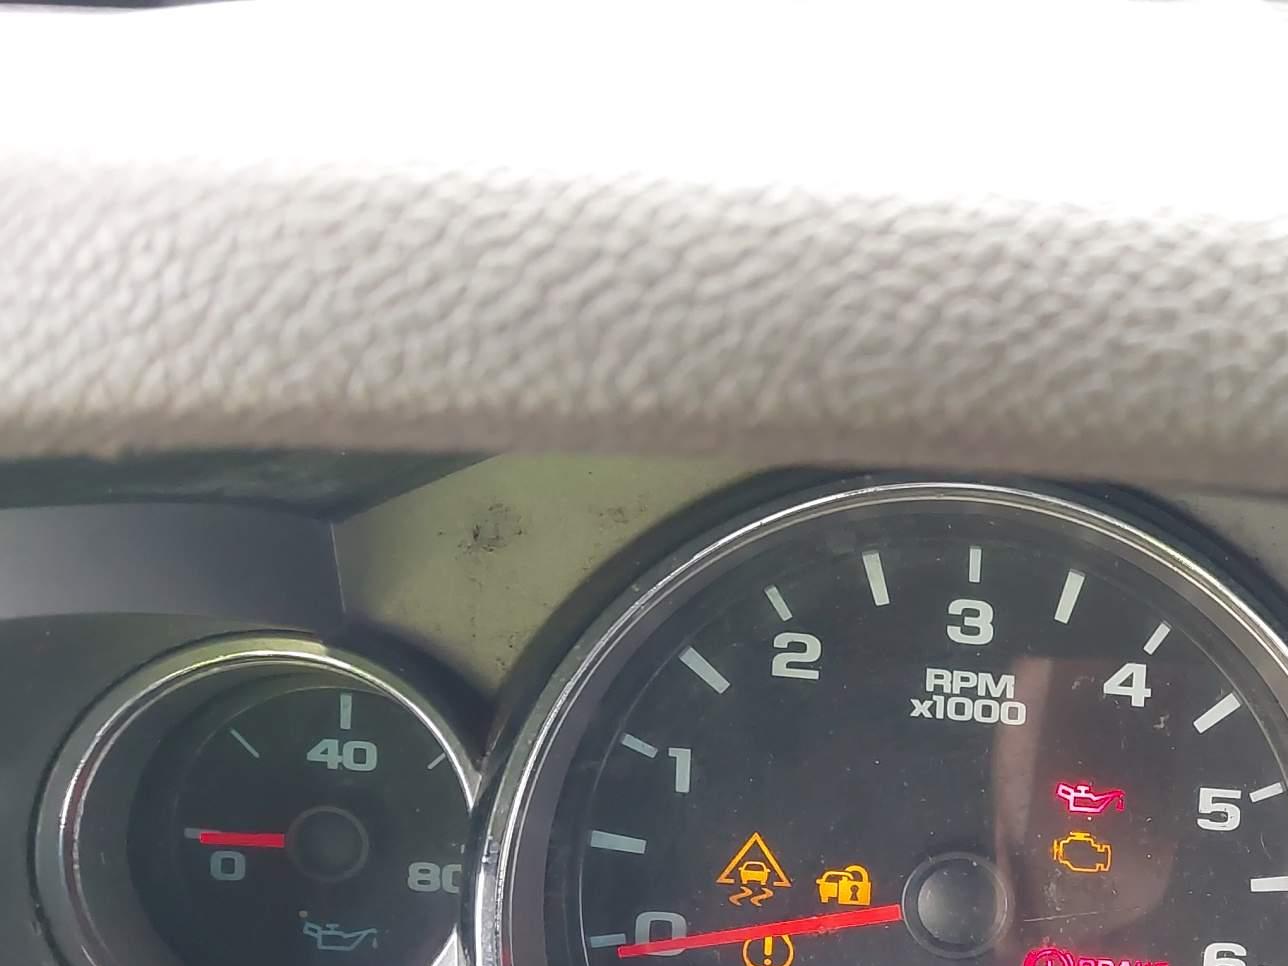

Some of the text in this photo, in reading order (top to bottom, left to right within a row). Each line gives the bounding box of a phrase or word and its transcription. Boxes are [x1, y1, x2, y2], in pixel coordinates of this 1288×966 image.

[946, 599, 994, 645] 3
[771, 632, 823, 680] 2
[925, 668, 1016, 699] RPM
[1103, 662, 1152, 707] 4
[910, 696, 1027, 726] x1000
[306, 737, 378, 771] 40
[668, 747, 692, 793] 1
[1197, 787, 1242, 832] 5
[210, 850, 246, 882] 0
[635, 911, 687, 957] 0
